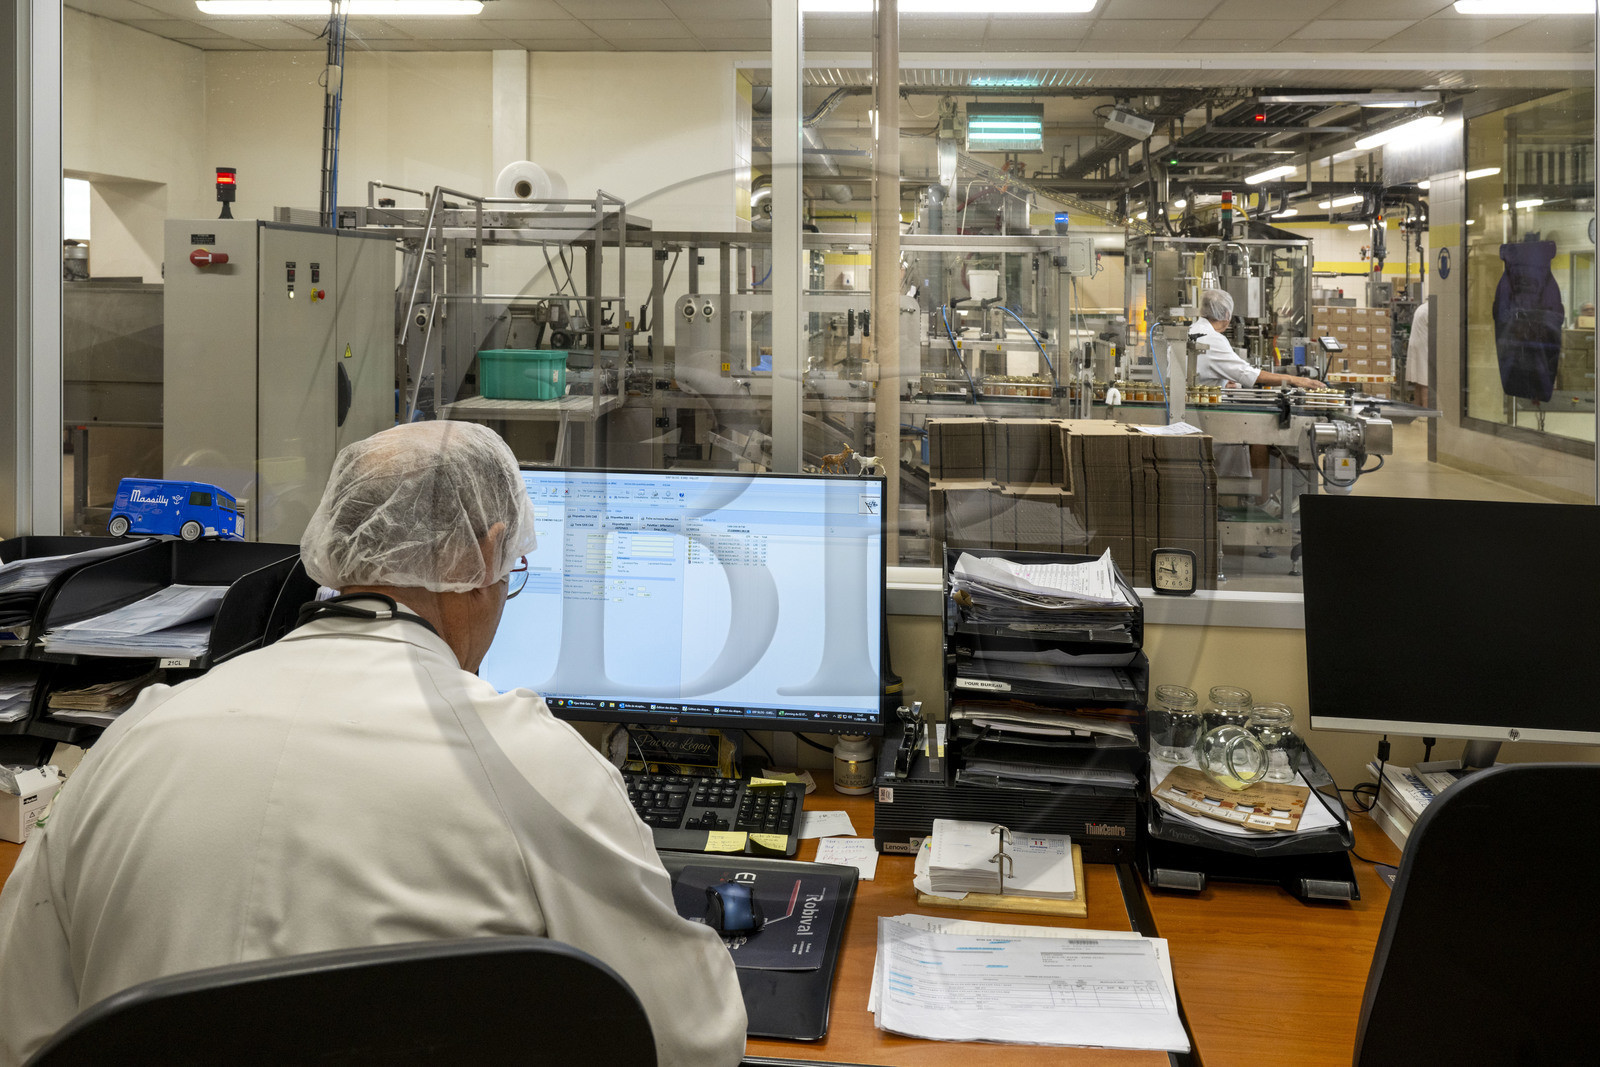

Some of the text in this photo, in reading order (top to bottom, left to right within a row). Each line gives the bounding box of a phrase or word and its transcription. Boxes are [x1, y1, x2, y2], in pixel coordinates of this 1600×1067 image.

[130, 489, 169, 507] Massilly
[1509, 728, 1519, 741] hp
[637, 734, 711, 753] Patrice Legay
[1085, 823, 1126, 836] ThinkCentre
[885, 843, 908, 851] Lenovo
[796, 889, 825, 936] Robival
